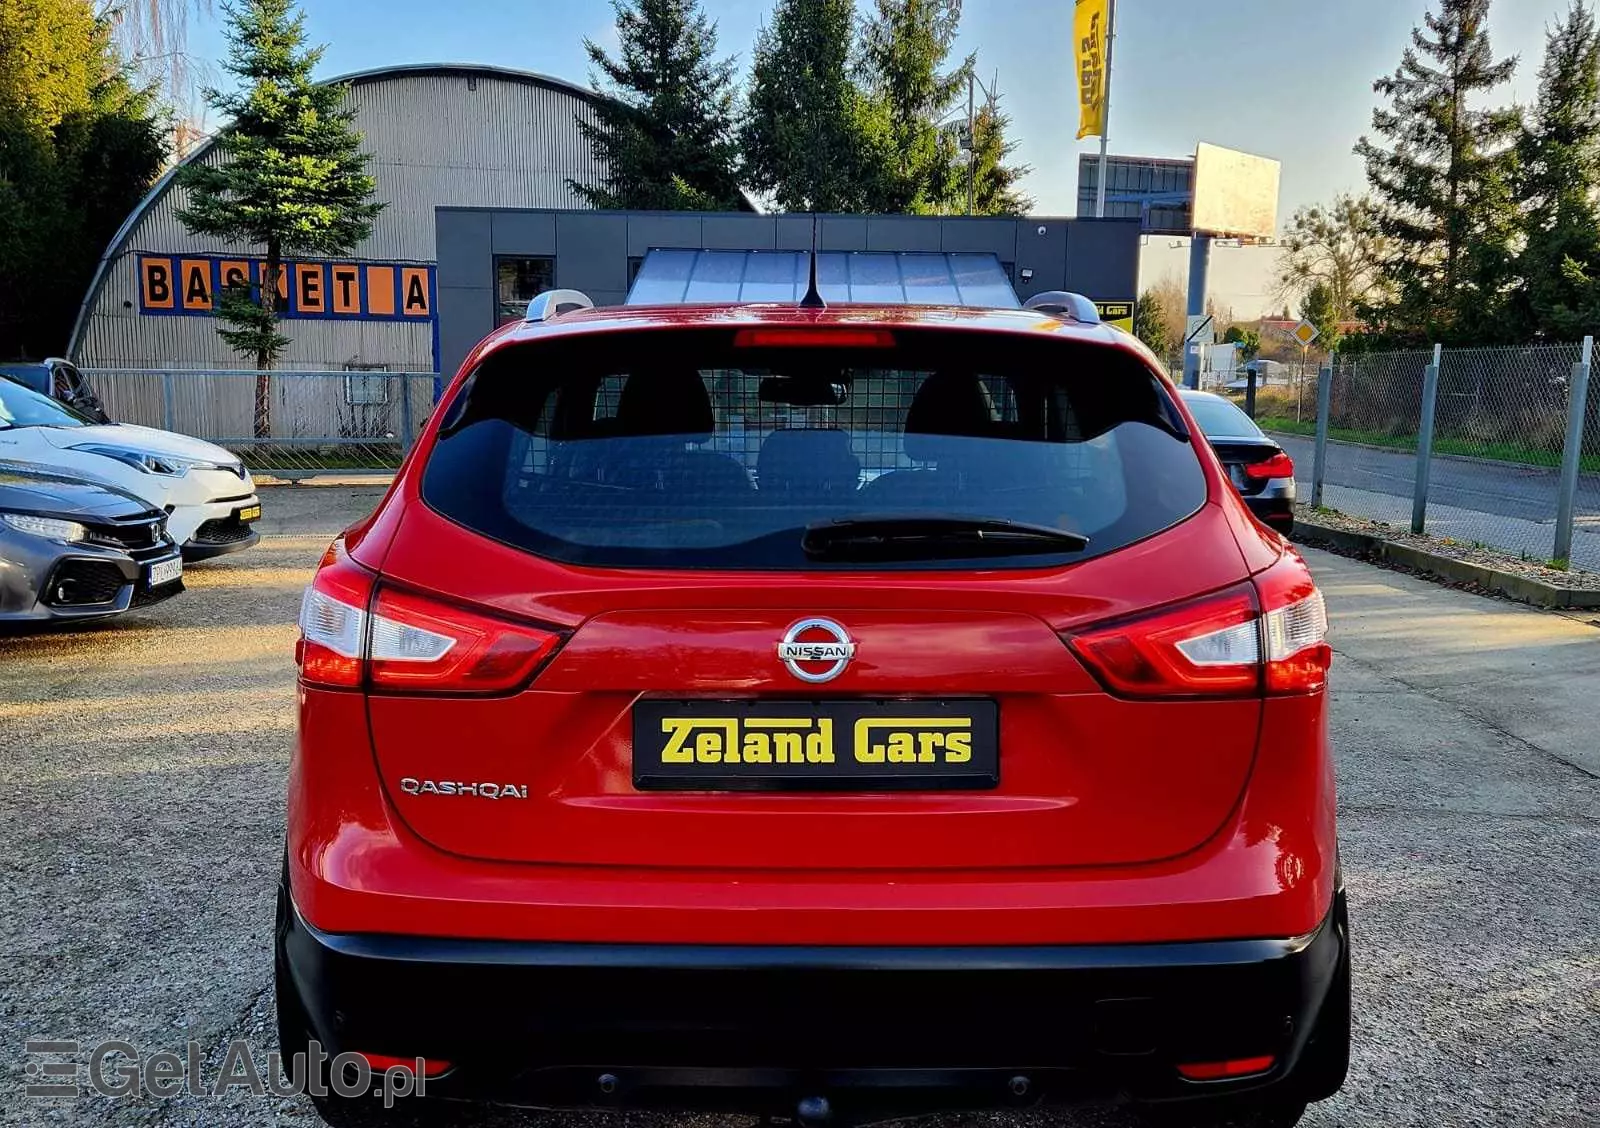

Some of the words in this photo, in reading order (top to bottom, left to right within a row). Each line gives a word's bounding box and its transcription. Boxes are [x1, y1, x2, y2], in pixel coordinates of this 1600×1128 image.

[786, 646, 847, 657] NISSAN
[661, 718, 835, 763] Zeland
[854, 718, 972, 763] Cars
